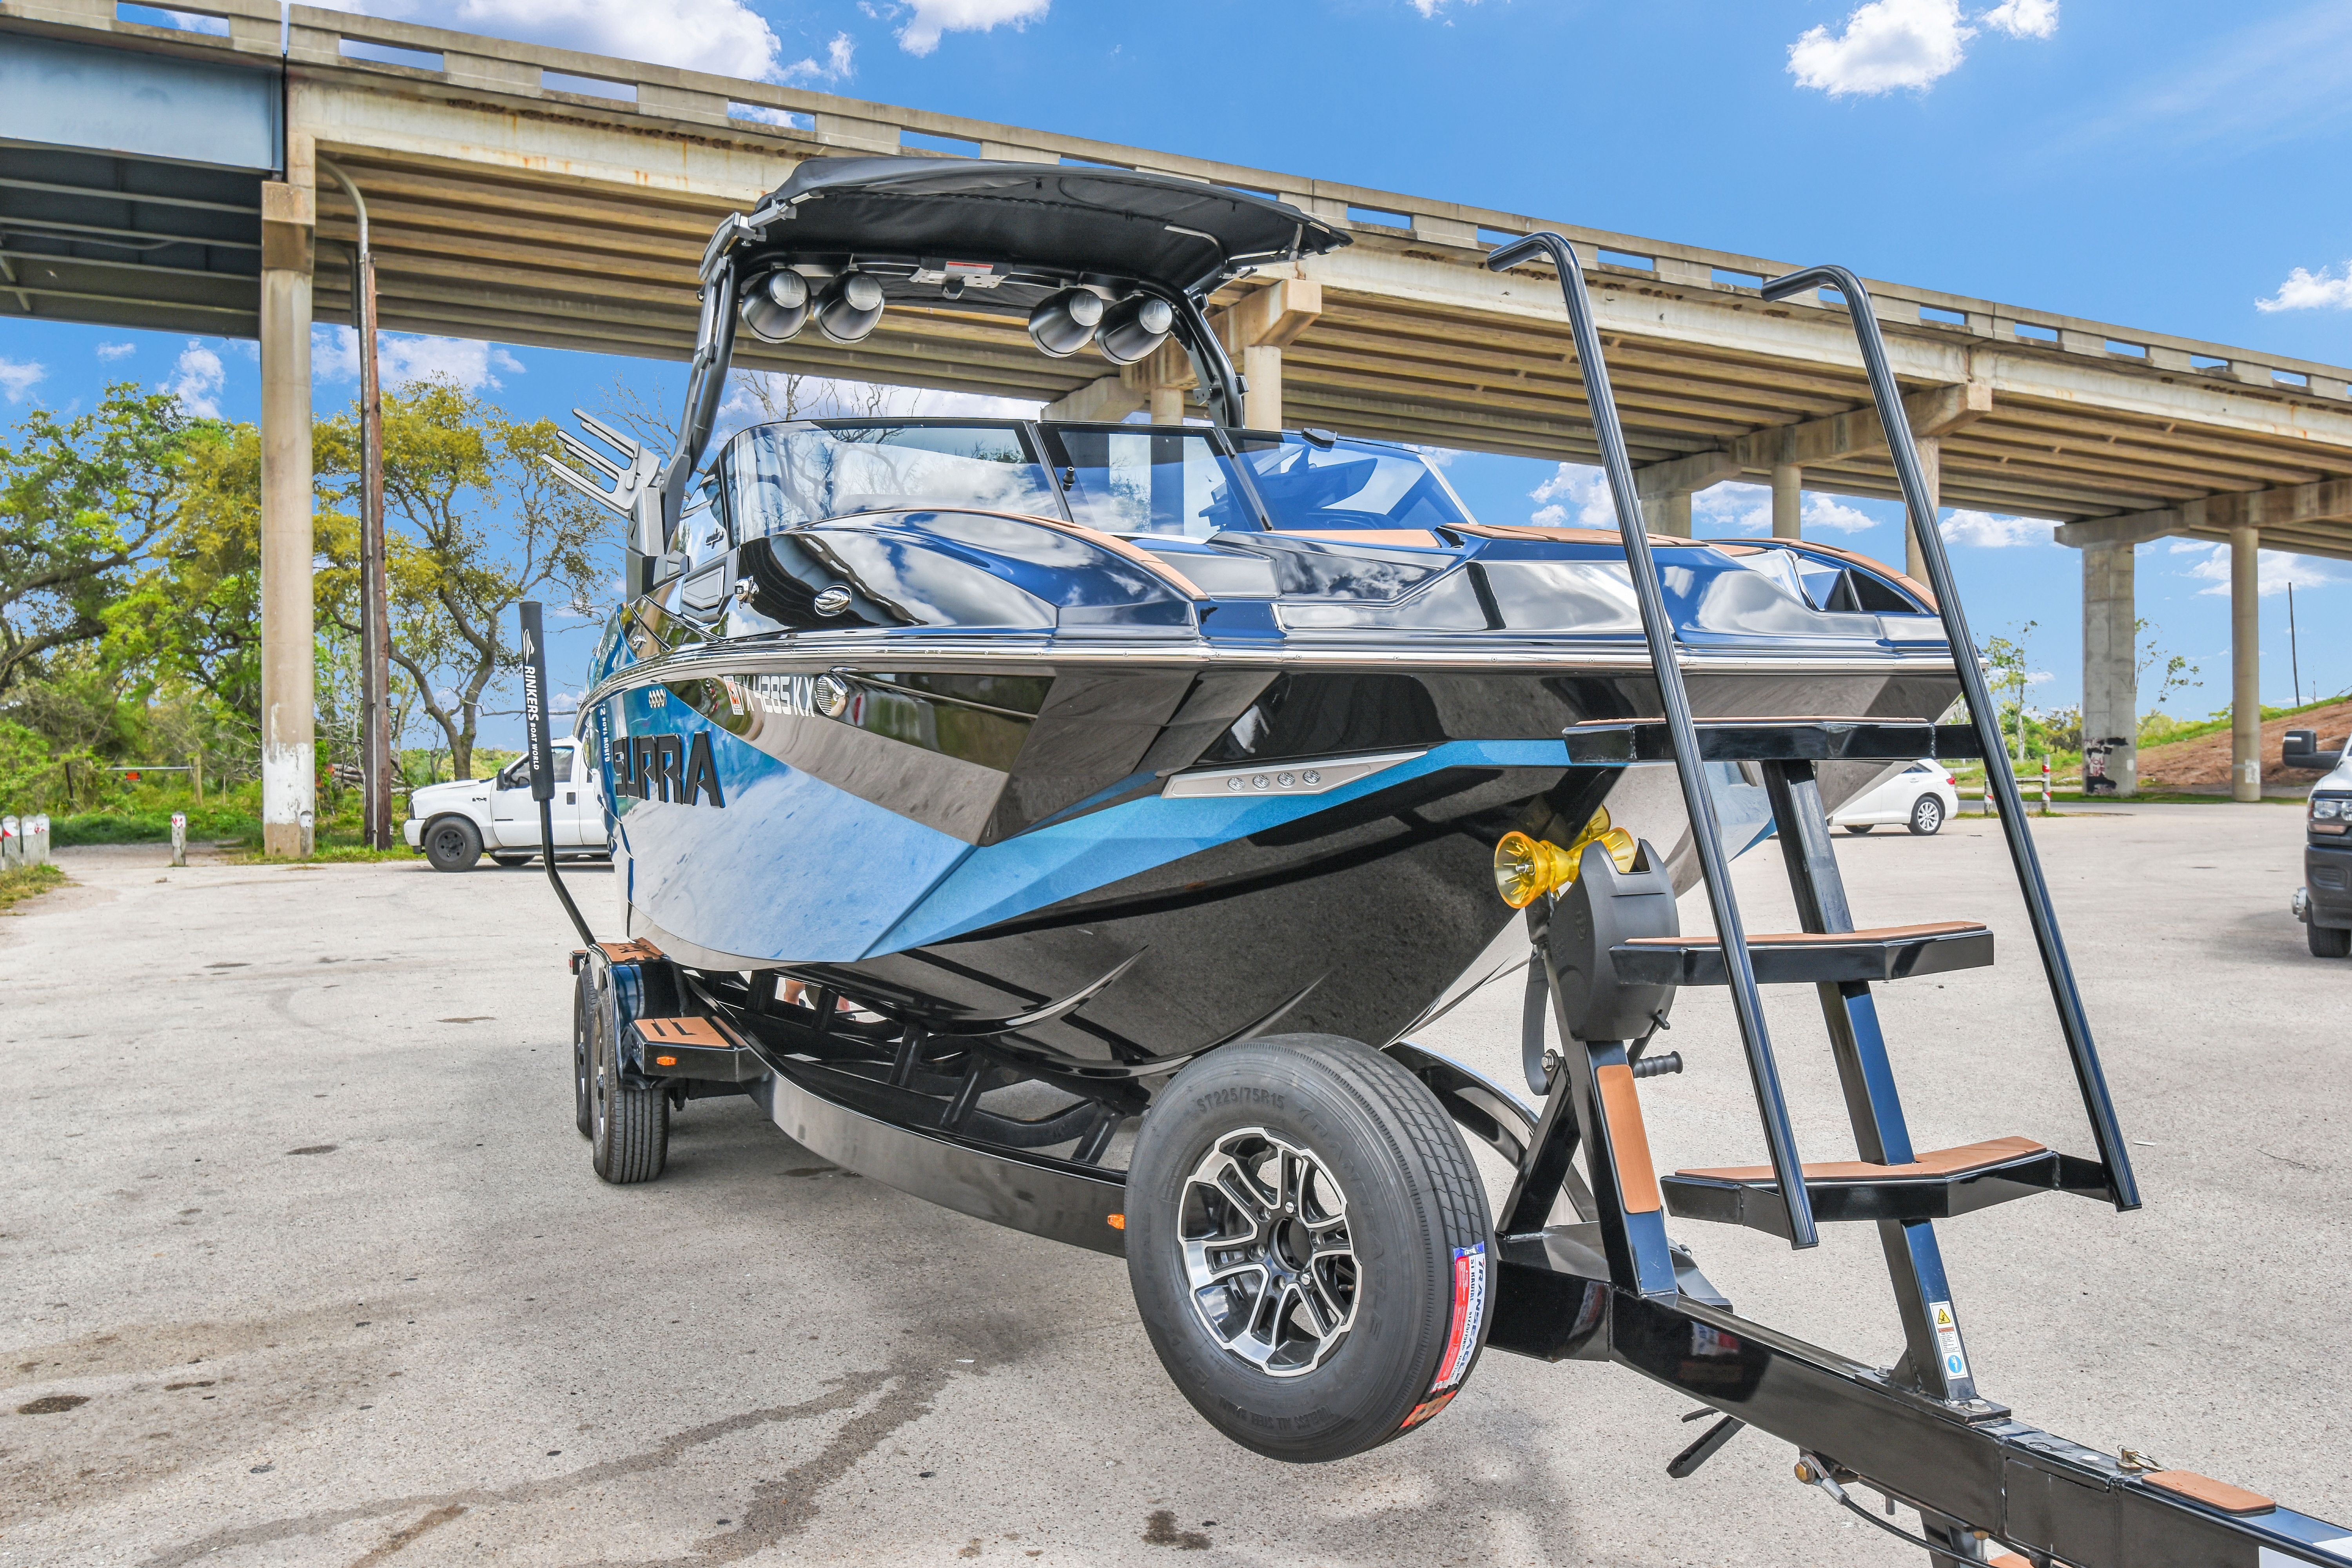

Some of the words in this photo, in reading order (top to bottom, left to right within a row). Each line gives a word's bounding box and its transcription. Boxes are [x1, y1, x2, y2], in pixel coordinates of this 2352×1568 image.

[524, 666, 539, 721] RINKERS
[532, 744, 540, 771] WORLD
[734, 675, 755, 711] TX
[753, 675, 792, 715] 4285
[793, 676, 816, 718] KX
[612, 730, 726, 809] SUPRA
[1196, 1086, 1285, 1113] ST225/75R15
